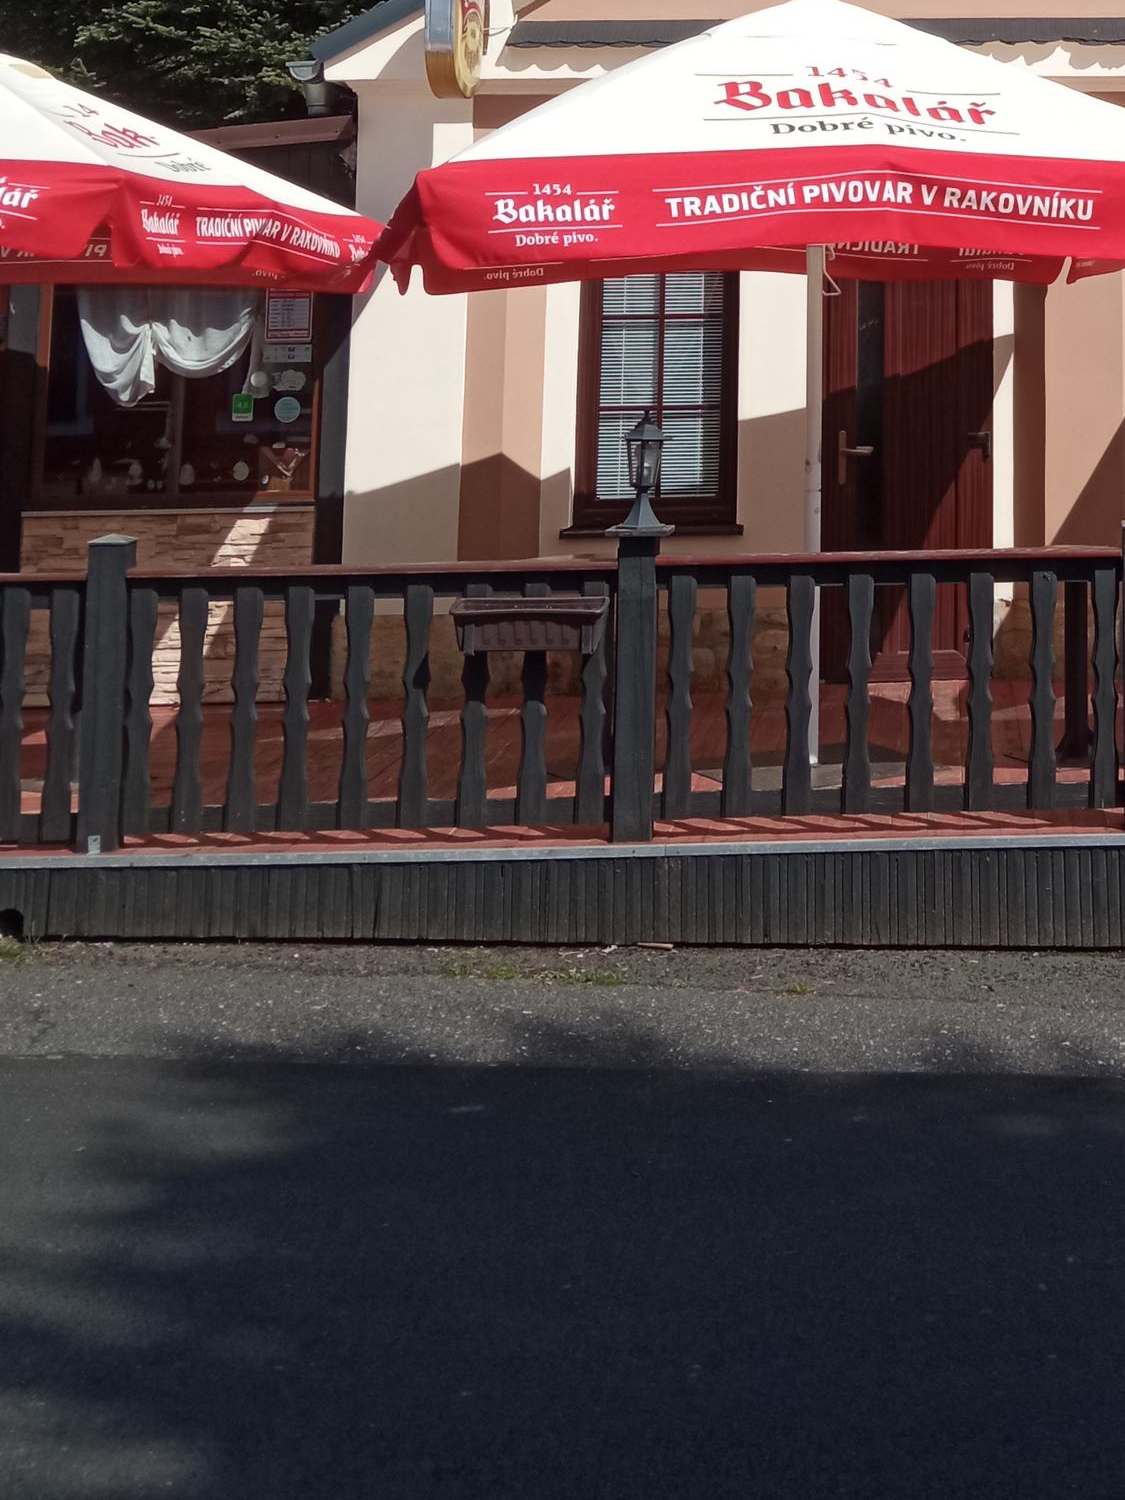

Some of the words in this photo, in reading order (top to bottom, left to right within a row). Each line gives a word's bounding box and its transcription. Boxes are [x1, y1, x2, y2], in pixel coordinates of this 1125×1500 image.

[806, 66, 893, 88] 1454
[714, 80, 996, 126] Bakalář
[769, 116, 874, 136] Dobré
[884, 122, 967, 142] pivo.
[533, 183, 572, 196] 1454
[665, 184, 797, 218] TRADIČNÍ
[803, 180, 912, 204] PIVOVAR
[921, 182, 938, 206] V
[944, 185, 1094, 221] RAKOVNÍKU
[493, 197, 616, 224] Bakalář
[196, 213, 243, 238] TRADIČNÍ
[515, 231, 559, 247] Dobré
[563, 232, 599, 247] pivo.
